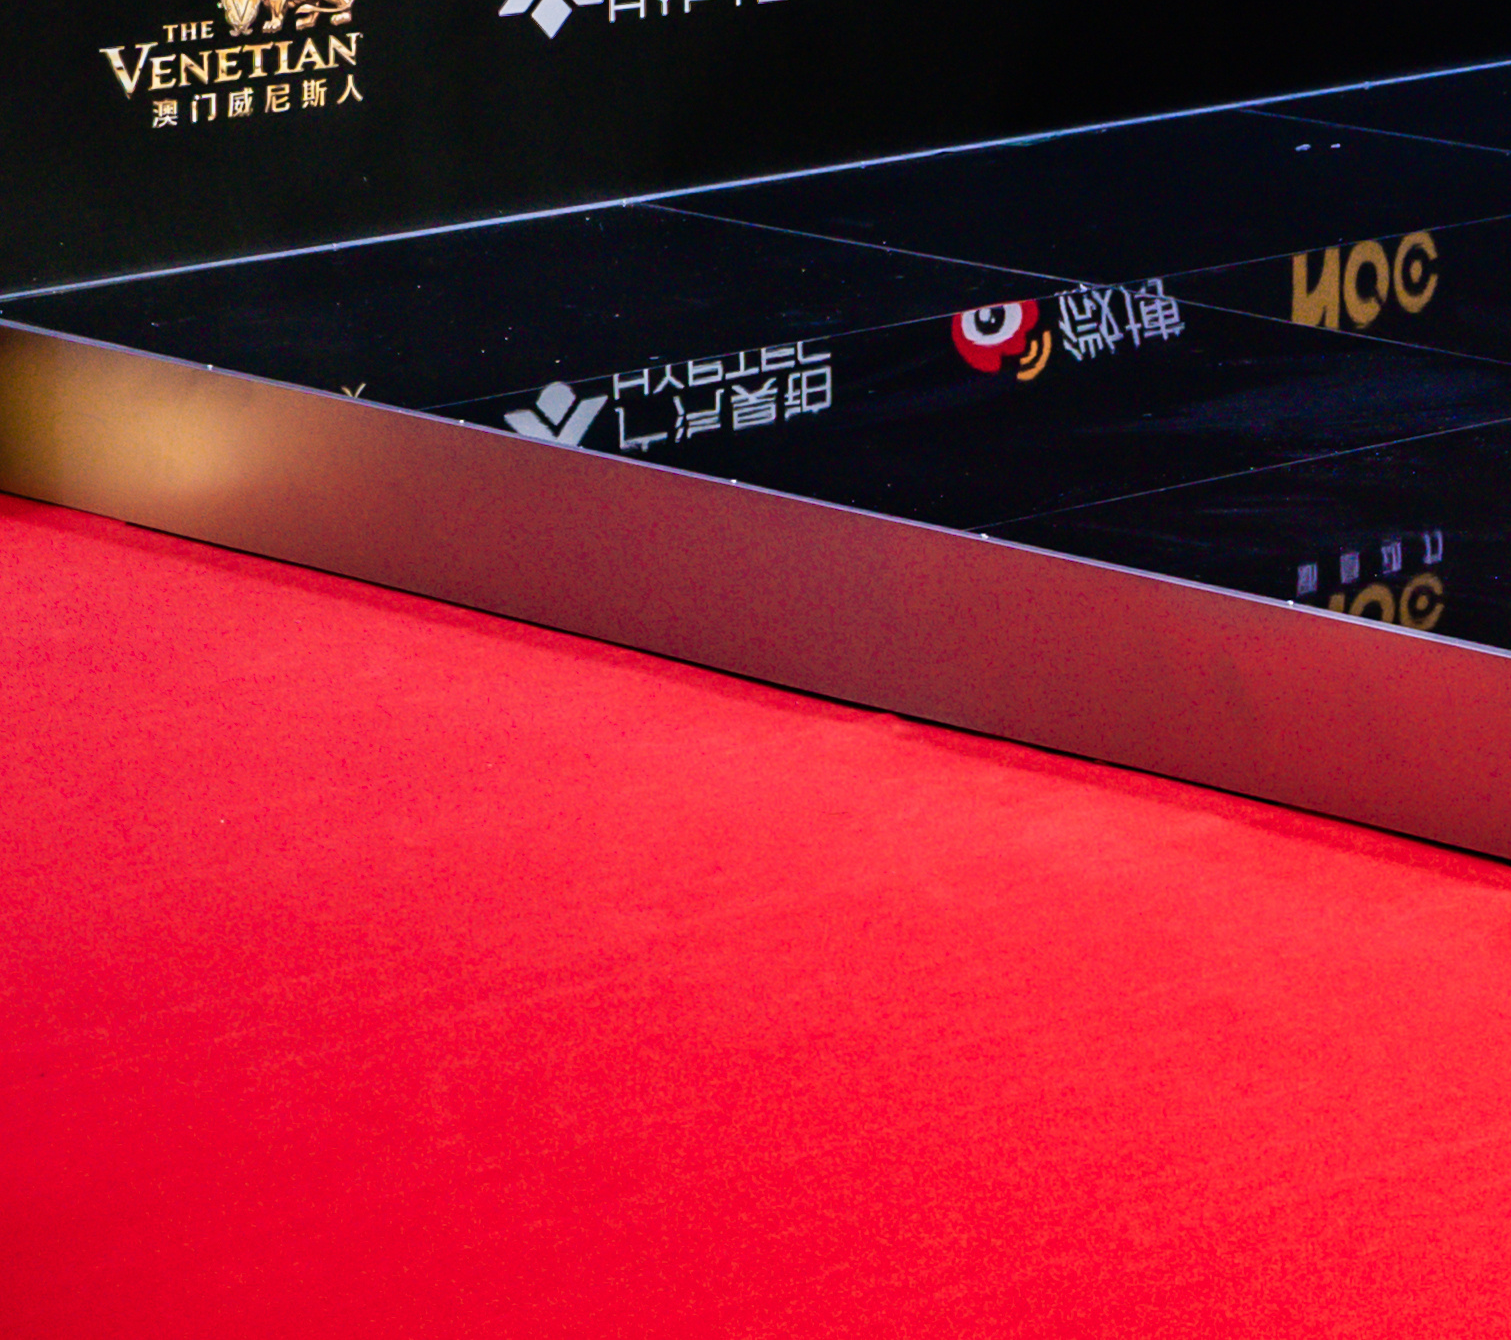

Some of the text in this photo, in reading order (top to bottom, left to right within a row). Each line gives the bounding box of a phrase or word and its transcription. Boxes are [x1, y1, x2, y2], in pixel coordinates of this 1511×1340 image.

[162, 19, 214, 41] THE
[98, 31, 364, 97] VENETIAN
[152, 73, 364, 128] 澳门威尼斯人
